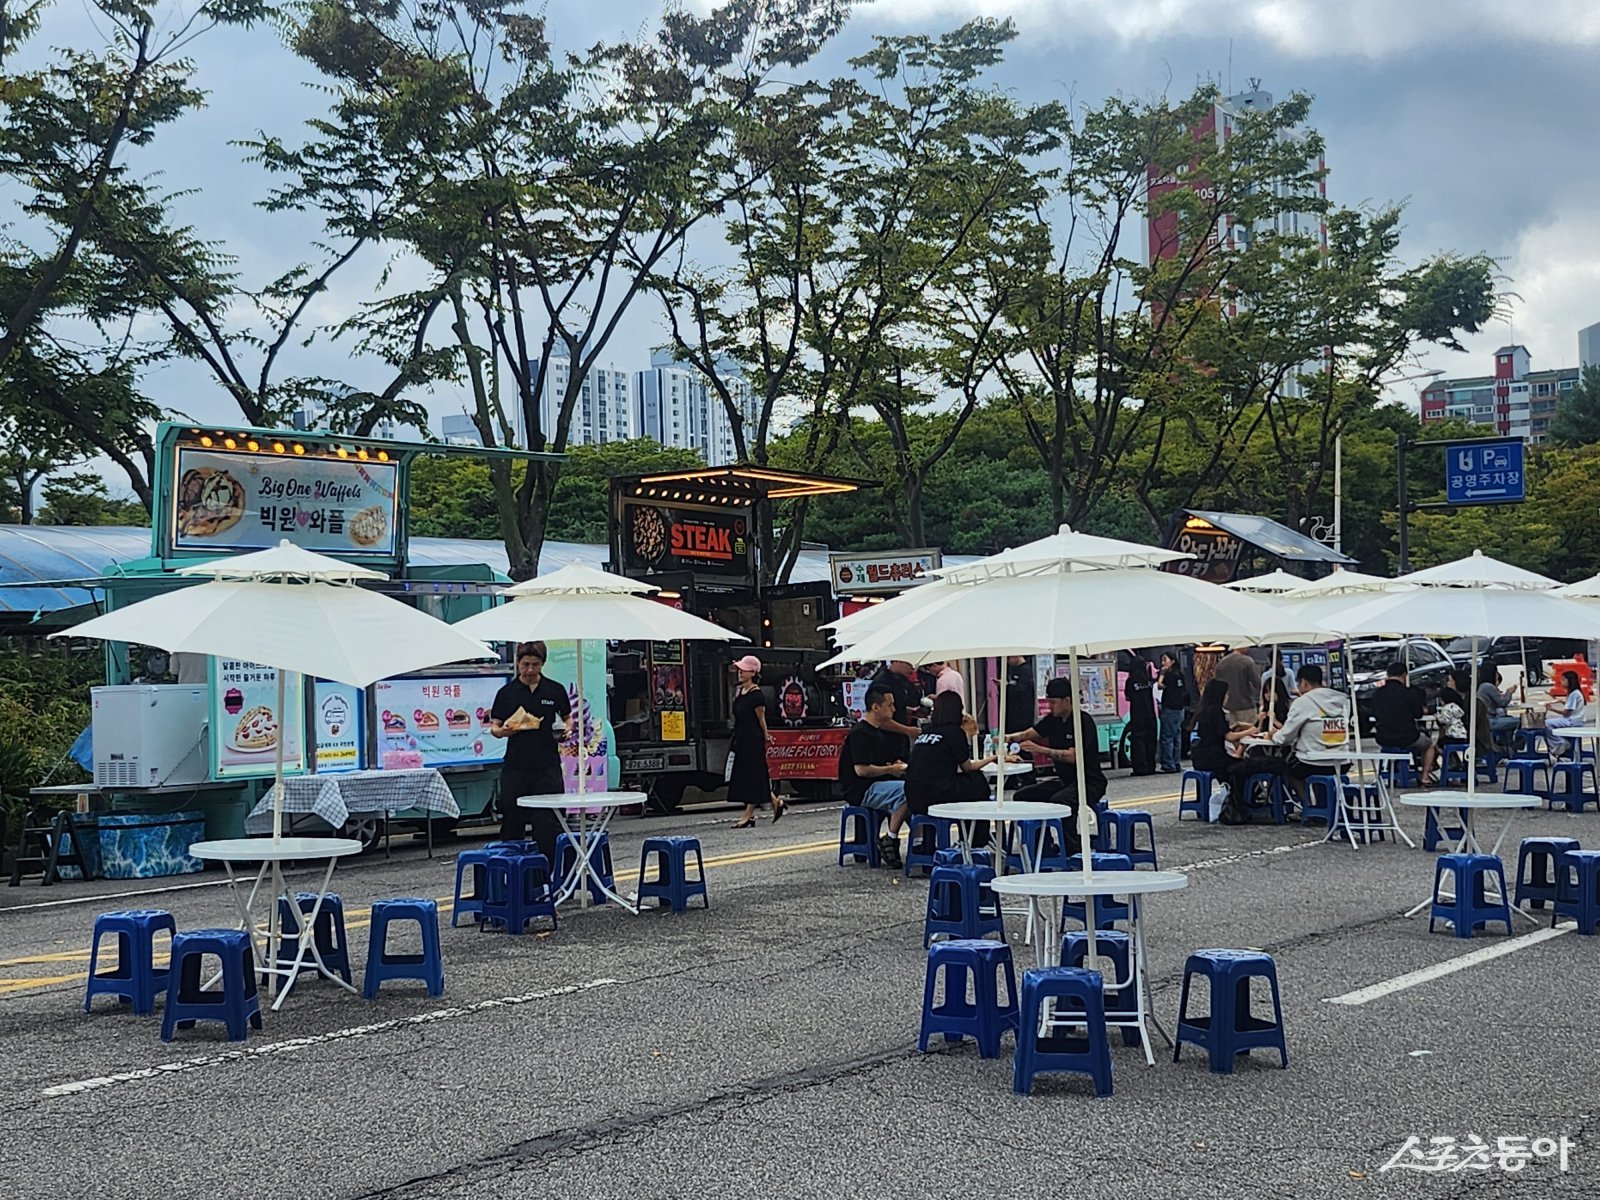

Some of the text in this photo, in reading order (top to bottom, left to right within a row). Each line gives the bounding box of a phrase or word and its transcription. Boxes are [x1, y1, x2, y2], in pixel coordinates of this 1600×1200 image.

[1483, 450, 1495, 465] P
[258, 476, 286, 499] Big
[286, 478, 312, 497] One
[1451, 471, 1520, 489] 공영주차장
[259, 505, 346, 535] 빅원 와플
[671, 522, 732, 553] STEAK
[422, 684, 461, 698] 빅원 와플
[1323, 718, 1346, 730] NIKE
